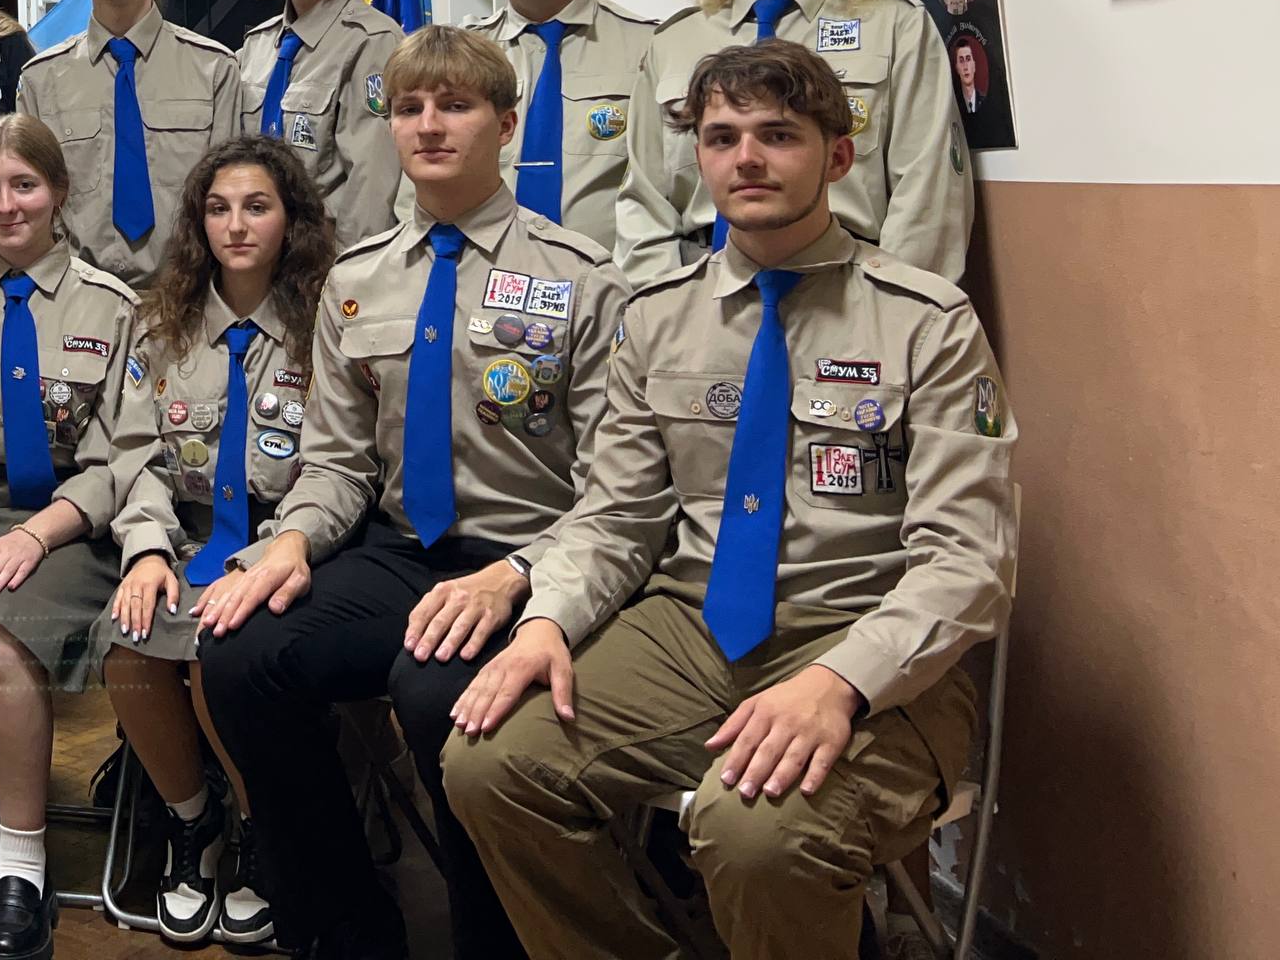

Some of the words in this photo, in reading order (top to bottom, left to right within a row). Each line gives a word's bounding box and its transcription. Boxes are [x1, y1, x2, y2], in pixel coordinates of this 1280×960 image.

[497, 293, 522, 306] 2019
[95, 342, 107, 352] 35
[861, 367, 877, 378] 35
[709, 393, 741, 405] ДОБА
[264, 440, 282, 450] СУМ
[827, 474, 858, 489] 2019
